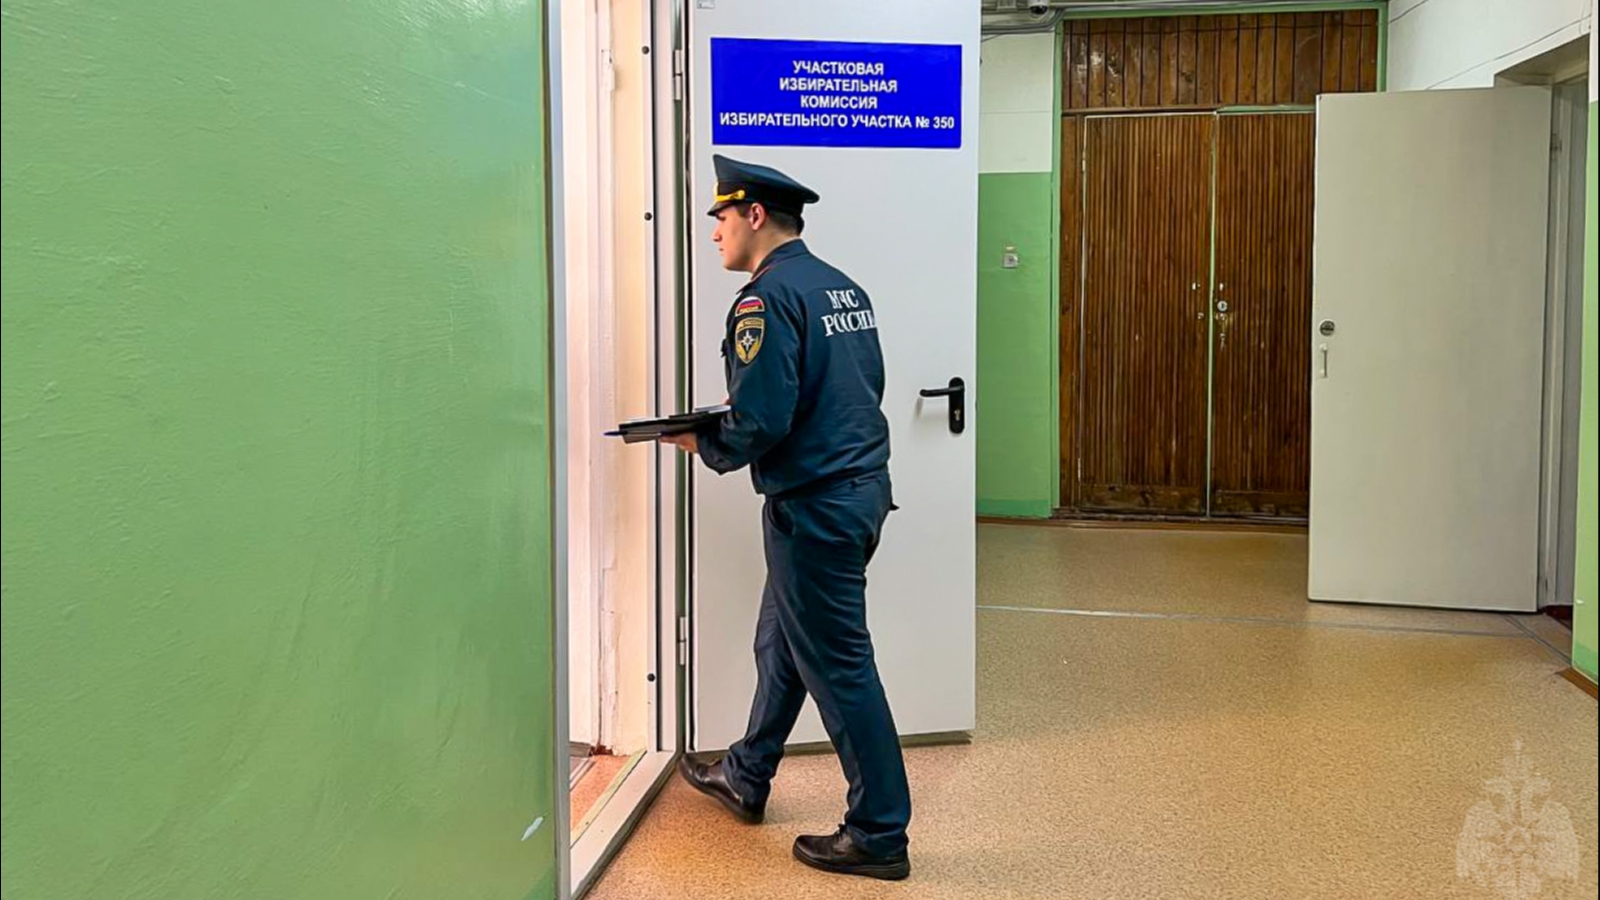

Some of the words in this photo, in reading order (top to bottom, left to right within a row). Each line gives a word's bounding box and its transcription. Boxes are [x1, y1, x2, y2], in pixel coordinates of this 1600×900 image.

[792, 60, 884, 75] УЧАСТКОВАЯ
[779, 77, 898, 93] ИЗБИРАТЕЛЬНАЯ
[800, 95, 878, 109] КОМИССИЯ
[719, 112, 848, 127] ИЗБИРАТЕЛЬНОГО
[851, 114, 912, 128] УЧАСТКА
[915, 115, 930, 128] №
[933, 116, 955, 129] 350
[825, 289, 859, 309] МЧС
